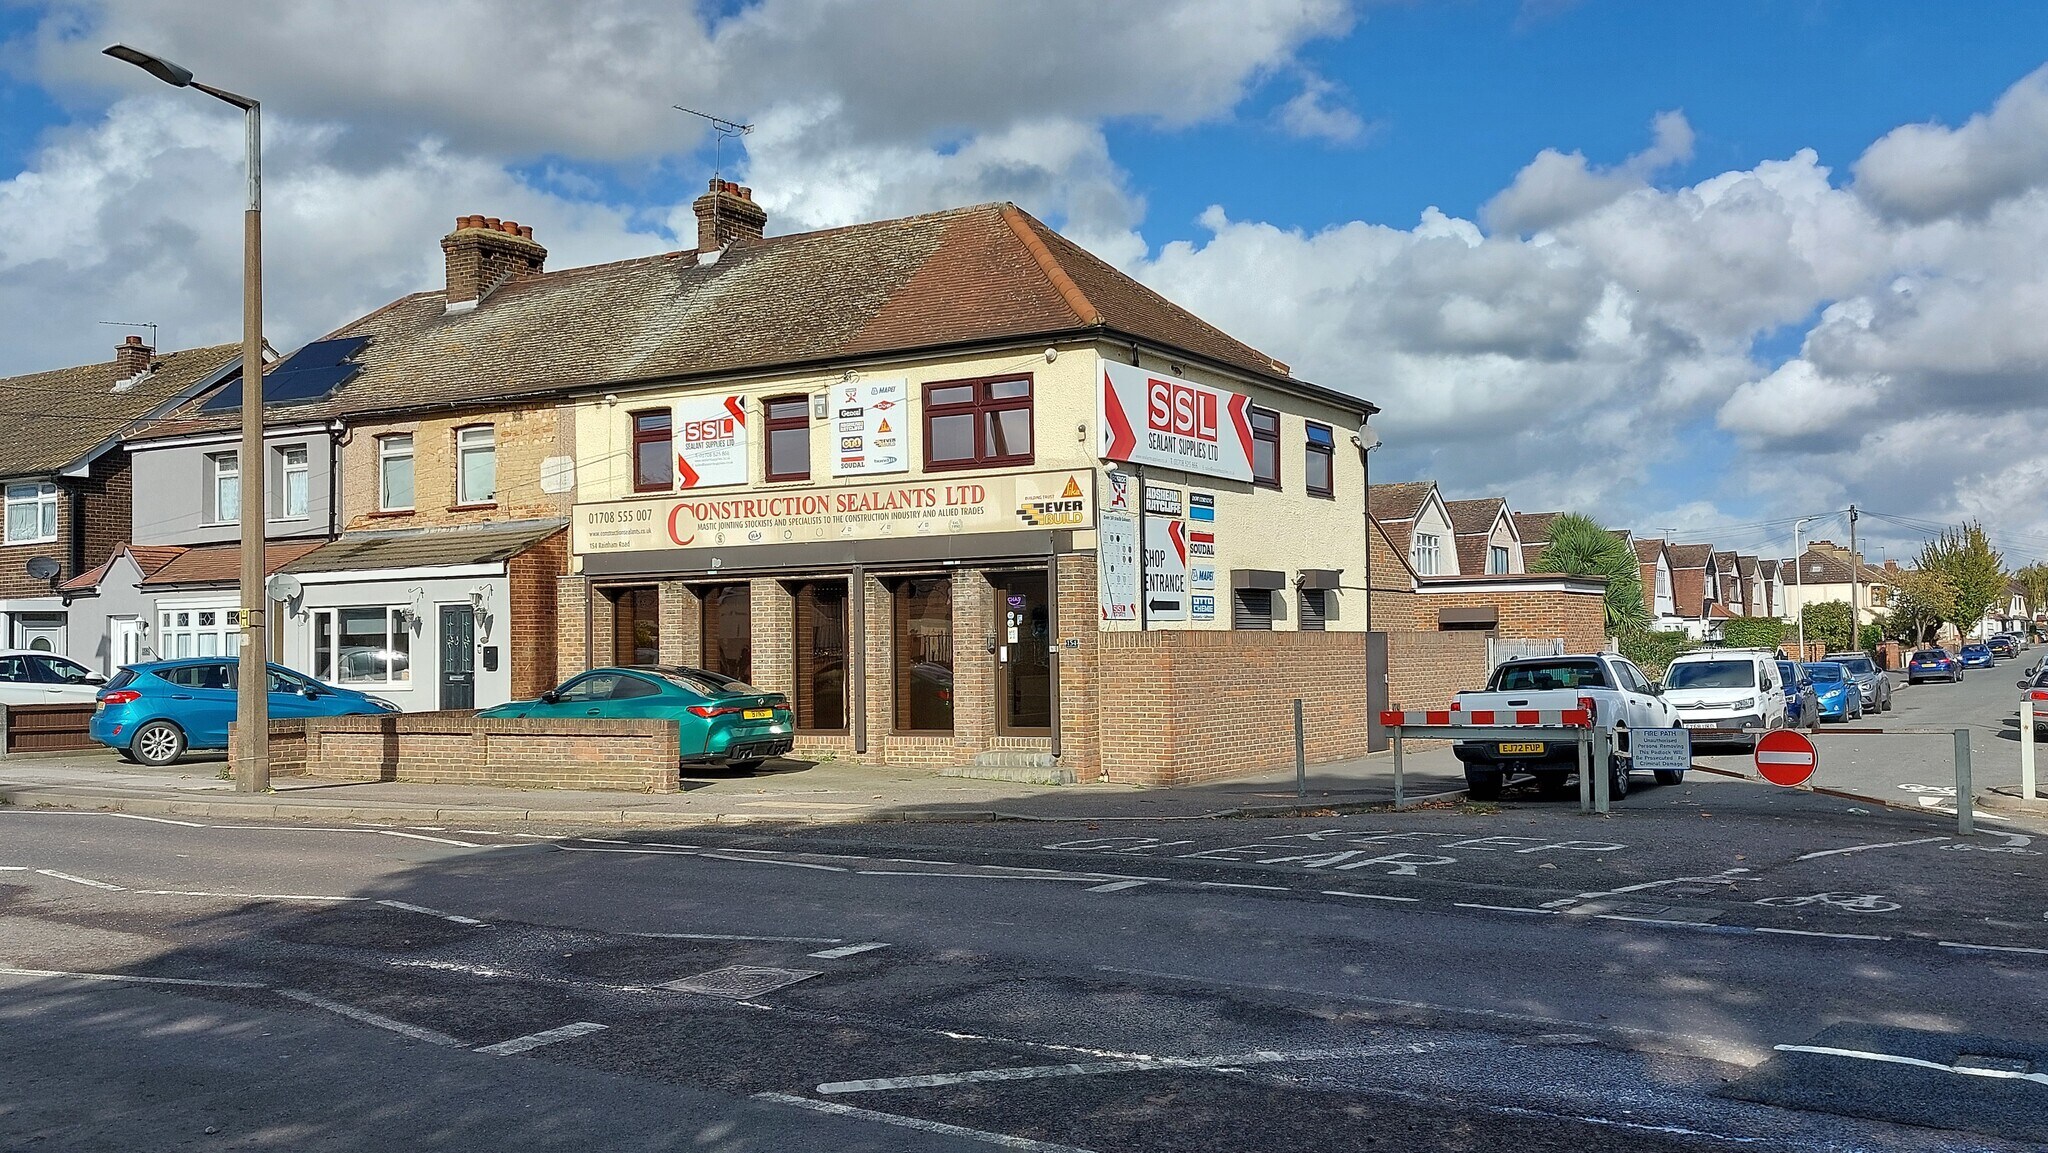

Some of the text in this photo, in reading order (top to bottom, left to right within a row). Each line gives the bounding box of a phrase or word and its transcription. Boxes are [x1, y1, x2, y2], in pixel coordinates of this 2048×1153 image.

[1150, 383, 1216, 439] SSL
[686, 419, 734, 440] SSL
[685, 439, 735, 451] SEALANT SUPPLIES LTD
[1148, 431, 1219, 462] SEALANT SUPPLIES LTD
[1145, 487, 1178, 502] ADSHEAD
[1045, 501, 1083, 513] EVER
[1145, 499, 1182, 514] RATCLIFFE
[588, 508, 652, 524] 01708 555 007
[667, 494, 830, 546] CONSTRUCTION
[836, 487, 936, 513] SEALANTS
[945, 484, 986, 506] LTD
[697, 506, 985, 531] MASTIC JOINTING STOCKISTS AND SPECIALISTS TO THE CONSTRUCTION INDUSTRY AND ALLIED TRADES
[1044, 512, 1084, 525] BUILD
[1190, 543, 1215, 556] SOUDAL
[1144, 548, 1166, 569] SHOP
[1144, 573, 1185, 593] ENTRANCE
[1502, 743, 1541, 753] EJ72 FUP
